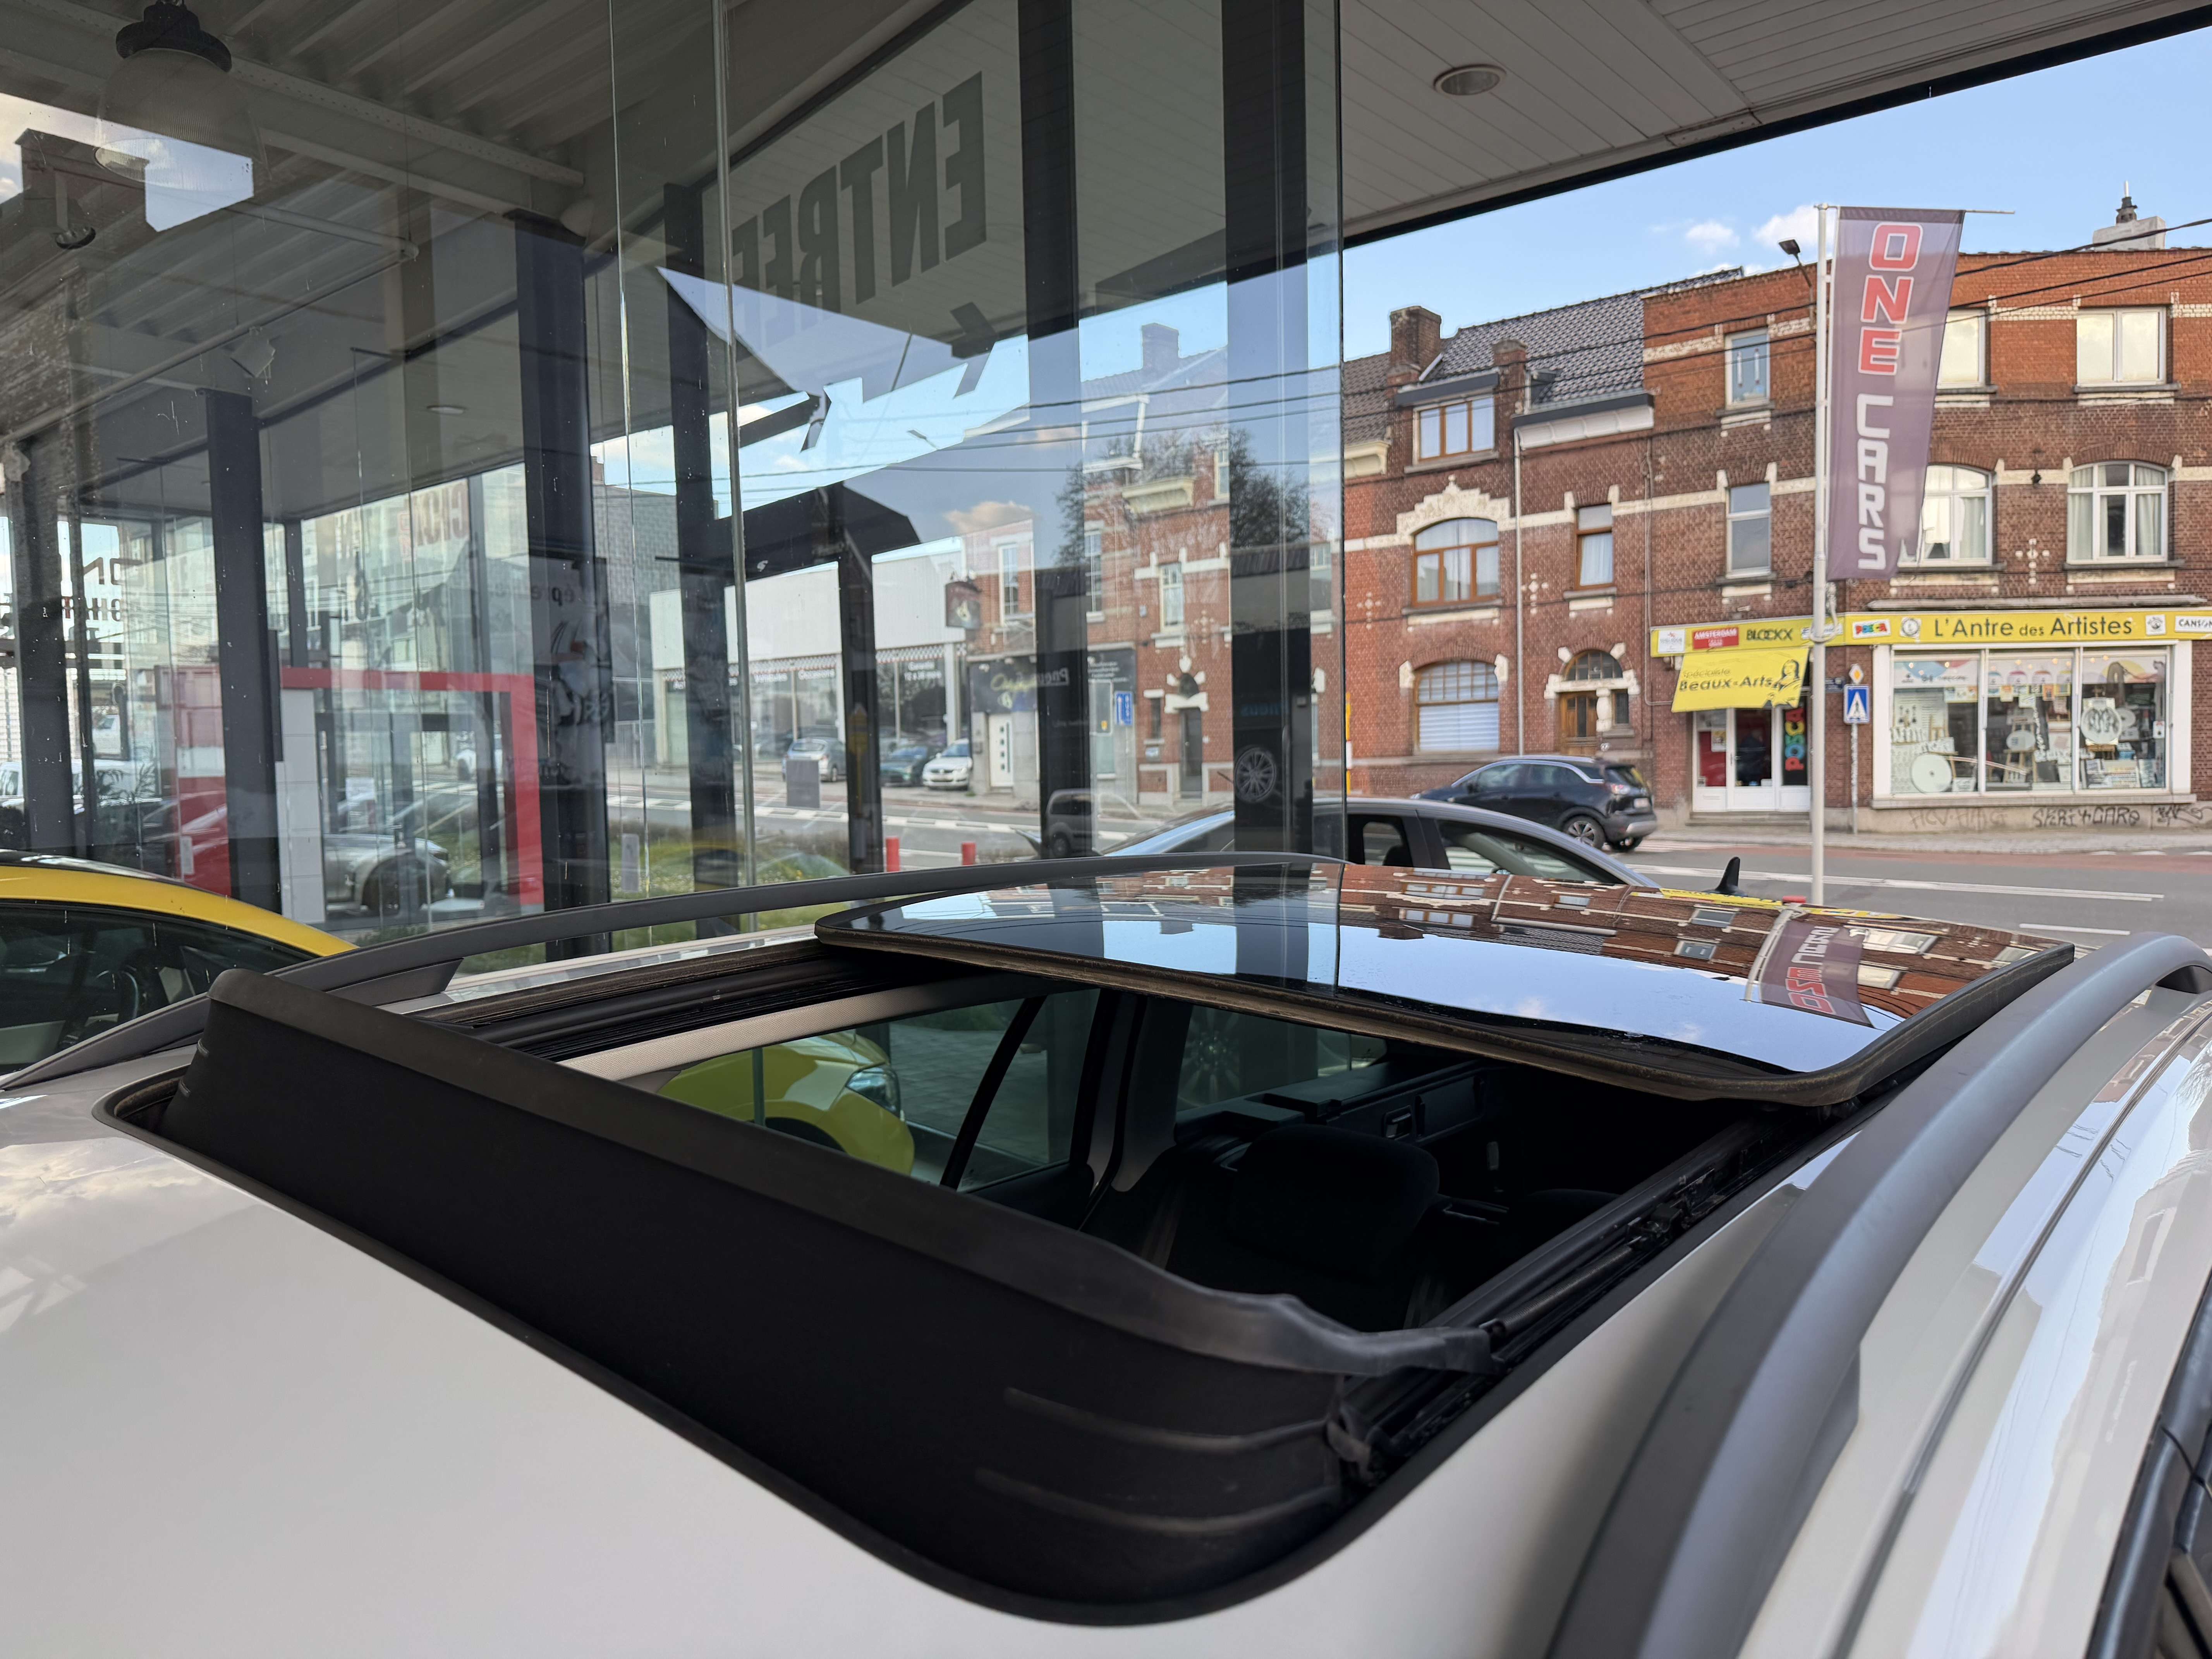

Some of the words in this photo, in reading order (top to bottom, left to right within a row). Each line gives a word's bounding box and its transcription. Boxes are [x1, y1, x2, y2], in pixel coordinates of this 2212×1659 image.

[1858, 222, 1923, 376] ONE
[1856, 393, 1894, 570] CARS
[1694, 628, 1737, 640] AMSTERDAM
[1747, 628, 1793, 641] BLOCKX
[1935, 617, 2014, 637] L'Antre
[2019, 624, 2045, 636] des
[2050, 615, 2133, 636] Artistes
[1784, 708, 1805, 771] POSCA
